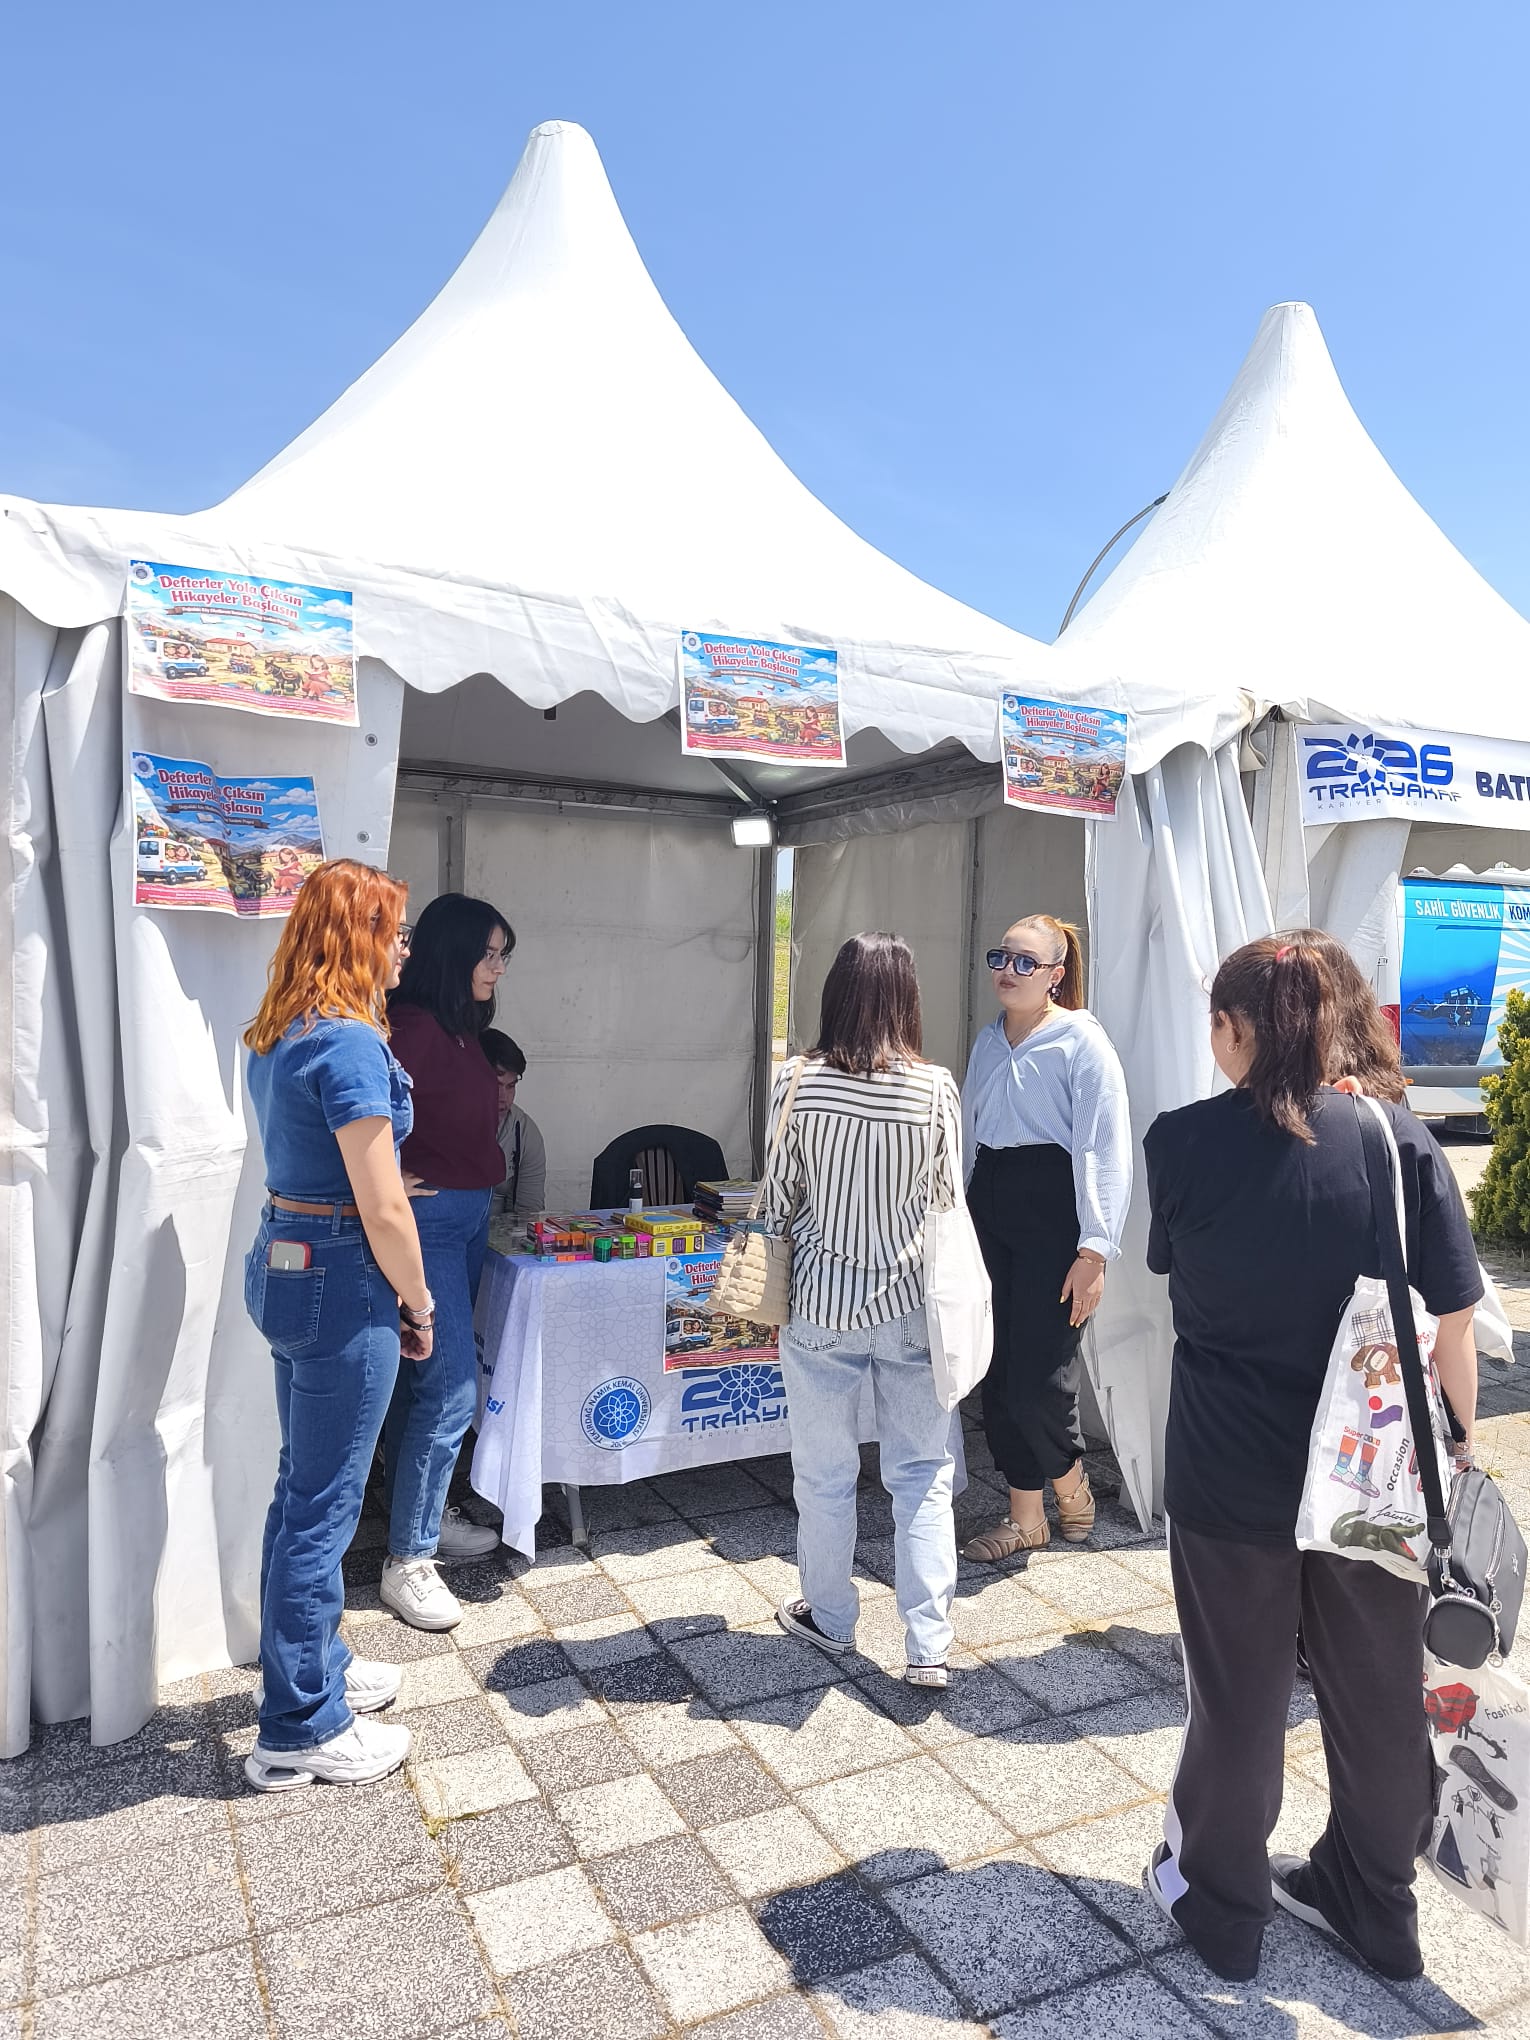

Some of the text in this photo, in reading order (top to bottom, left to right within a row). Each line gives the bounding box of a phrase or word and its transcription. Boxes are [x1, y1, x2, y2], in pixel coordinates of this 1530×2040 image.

[159, 575, 302, 607] Defterler Yola Çıksın
[171, 590, 239, 605] Hikayeler
[242, 595, 298, 618] Başlasın
[703, 643, 801, 665] Defterler Yola Çıksın
[712, 655, 798, 676] Hikayeler Başlasın
[1021, 706, 1101, 726] Defterler Yola Çıksın
[1026, 717, 1098, 736] Hikayeler Başlasın
[1303, 733, 1454, 786] 2026
[222, 785, 265, 801] Çıksın
[1414, 897, 1449, 917] SAHİL
[1450, 898, 1502, 919] GÜVENLİK
[685, 1260, 720, 1275] Defterle
[588, 1384, 612, 1407] NAMIK
[612, 1380, 637, 1392] KEMAL
[1386, 1437, 1411, 1492] occasion
